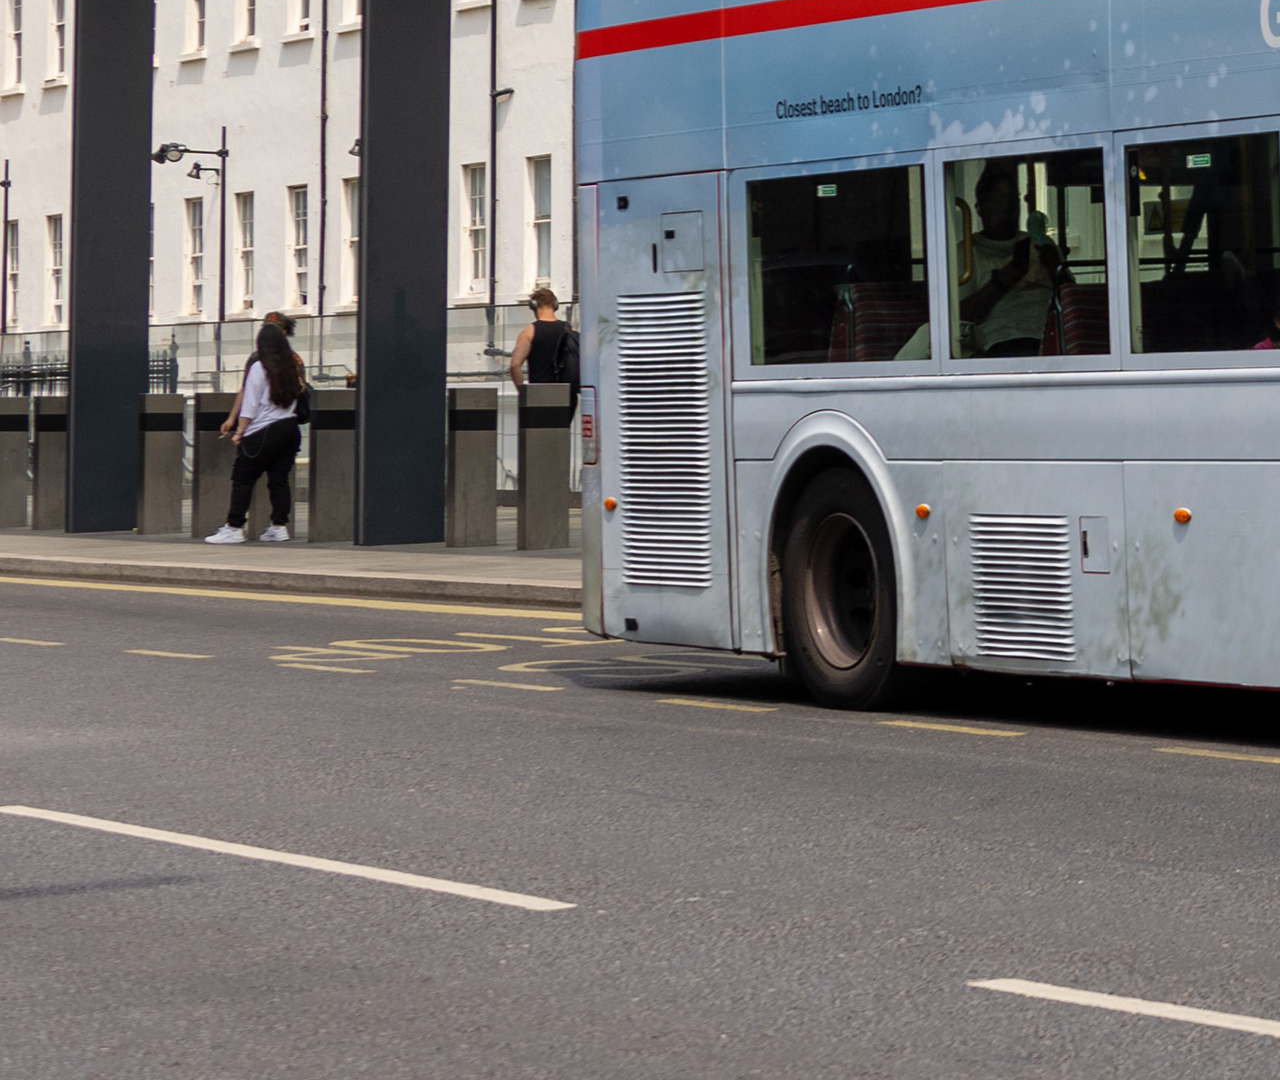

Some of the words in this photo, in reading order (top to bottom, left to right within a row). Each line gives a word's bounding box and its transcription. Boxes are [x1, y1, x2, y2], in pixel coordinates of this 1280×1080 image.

[775, 97, 819, 120] Closest
[820, 91, 855, 115] beach
[857, 92, 870, 110] to
[872, 84, 922, 109] London?
